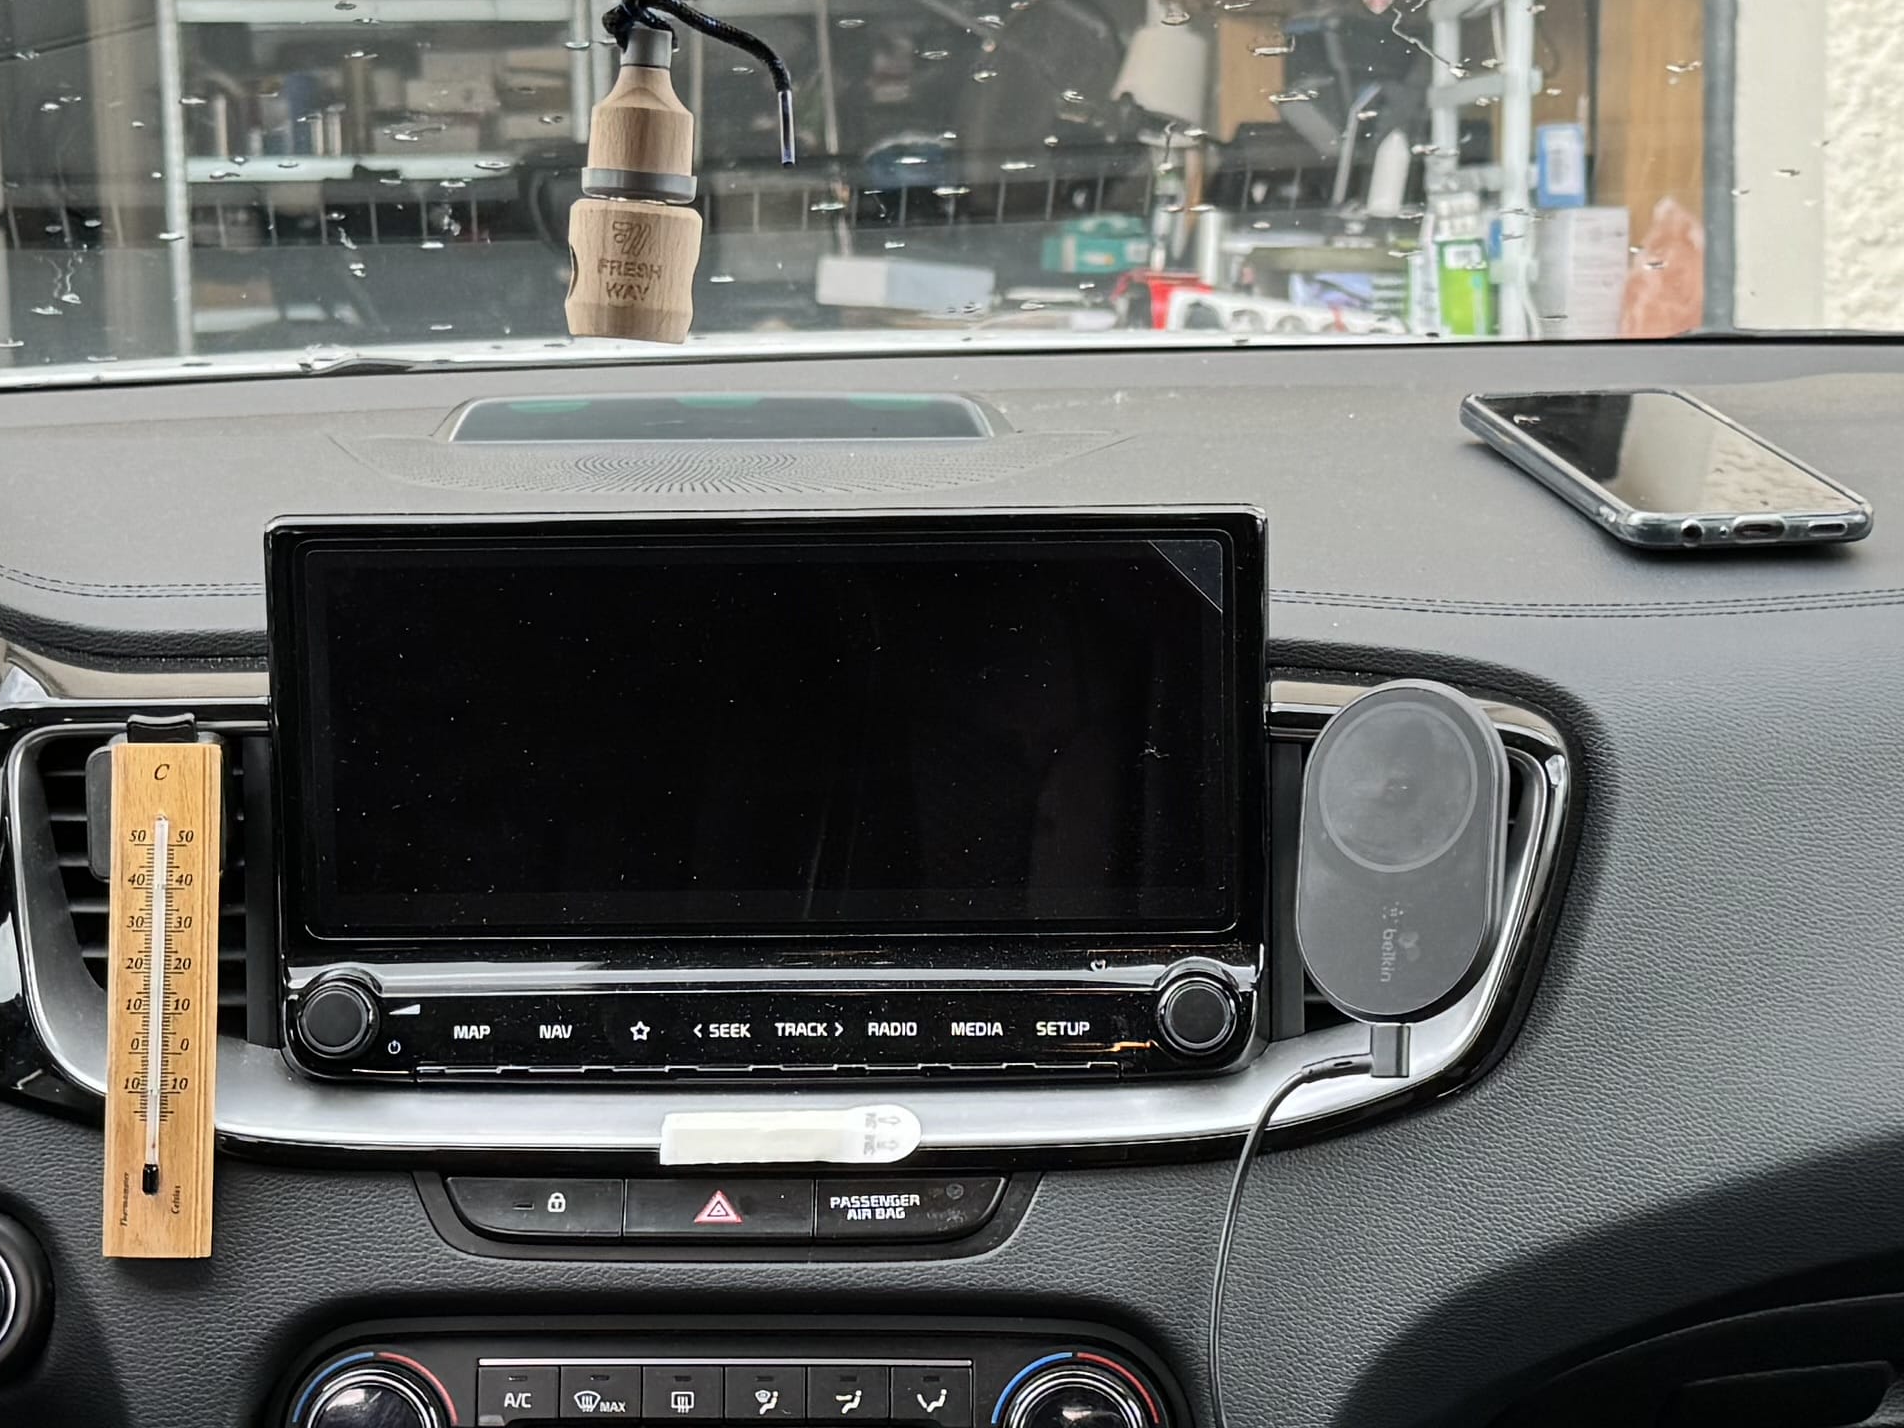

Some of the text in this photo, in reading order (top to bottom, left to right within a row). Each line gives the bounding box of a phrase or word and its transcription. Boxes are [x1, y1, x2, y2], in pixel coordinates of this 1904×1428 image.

[598, 258, 663, 281] FRESH
[153, 762, 171, 781] C
[129, 830, 194, 843] 50 50
[128, 873, 193, 886] 40 40
[126, 915, 192, 928] 30 30
[1380, 928, 1397, 983] belkin
[125, 957, 192, 970] 20 20
[125, 998, 191, 1011] 10 10
[453, 1020, 1090, 1040] MAP NAV SEEK TRACK RADIO MEDIA SETUP
[130, 1037, 190, 1051] 0 0
[123, 1077, 189, 1090] 10 10
[829, 1194, 921, 1209] PASSENGER
[847, 1207, 907, 1221] AIR BAG
[503, 1392, 533, 1408] A/C
[599, 1401, 627, 1413] MAX
